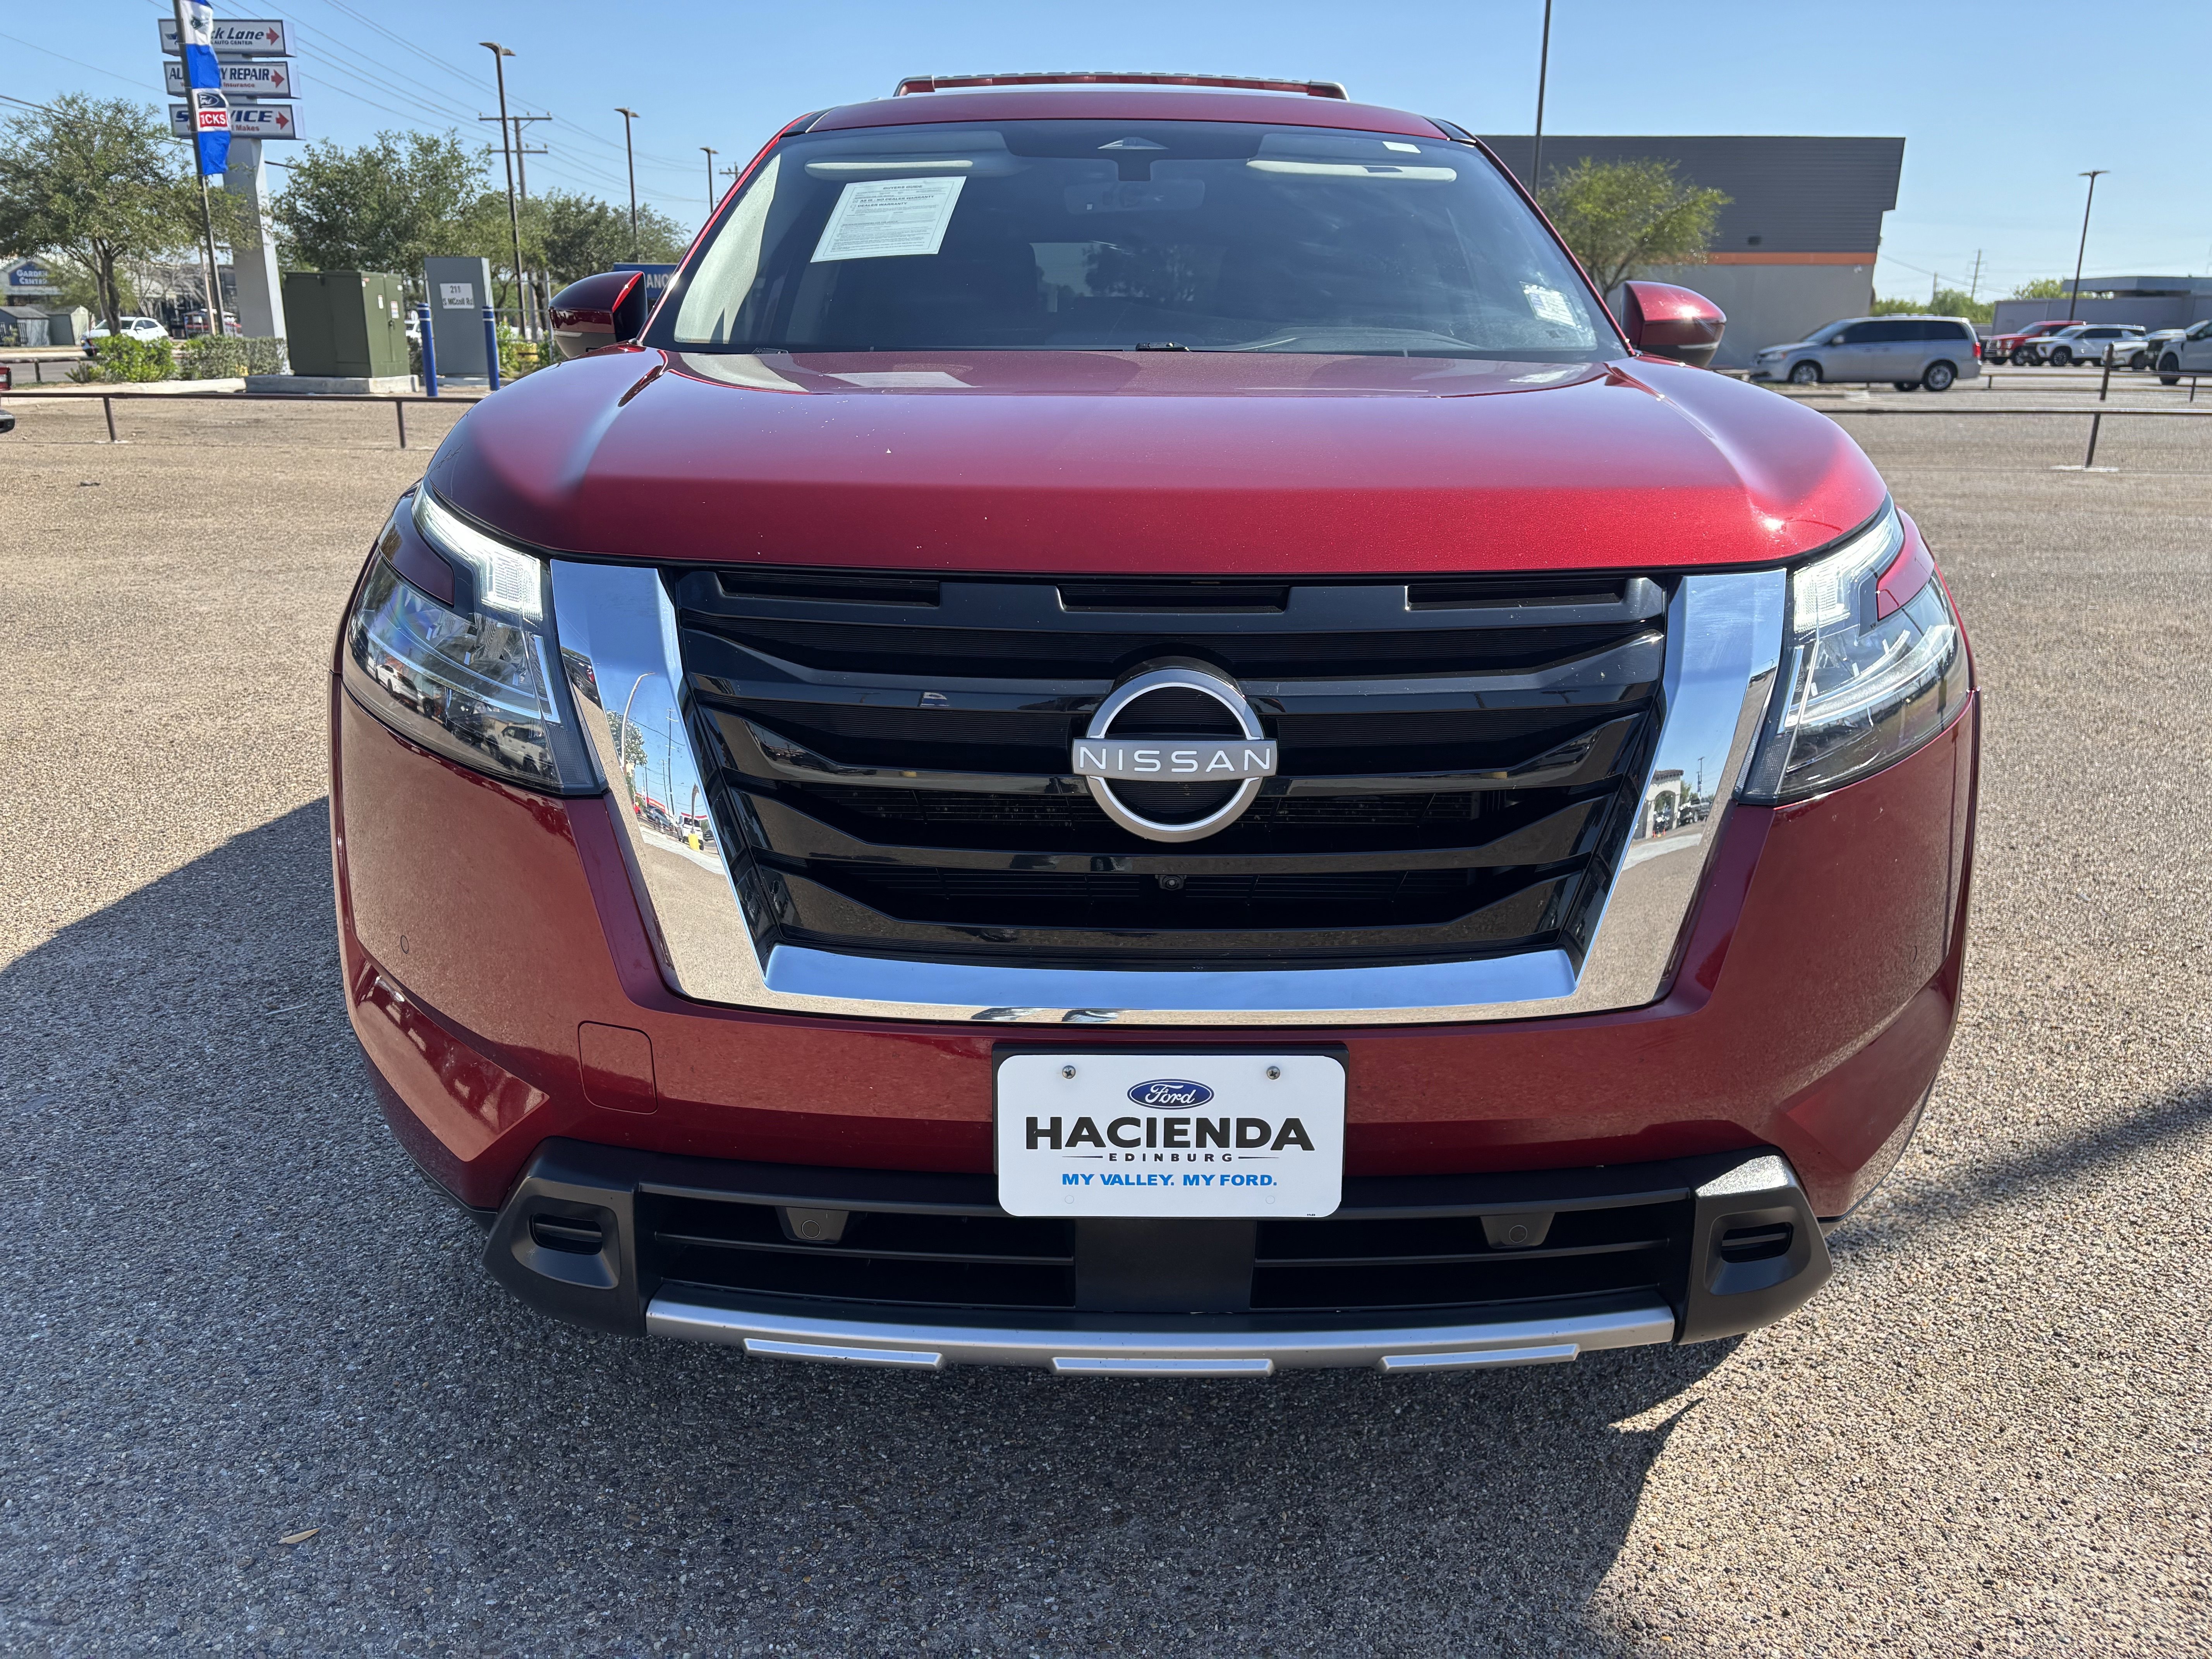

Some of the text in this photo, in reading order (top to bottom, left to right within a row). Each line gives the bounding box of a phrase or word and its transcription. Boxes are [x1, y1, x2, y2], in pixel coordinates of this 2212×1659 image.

[227, 27, 264, 40] Lane
[229, 68, 270, 81] REPAIR
[450, 285, 461, 294] 211
[1080, 747, 1270, 773] NISSAN
[1145, 1084, 1197, 1104] Ford
[1026, 1116, 1315, 1151] HACIENDA
[1109, 1153, 1232, 1162] EDINBURG
[1062, 1174, 1277, 1186] MY VALLEY. MY FORD.
